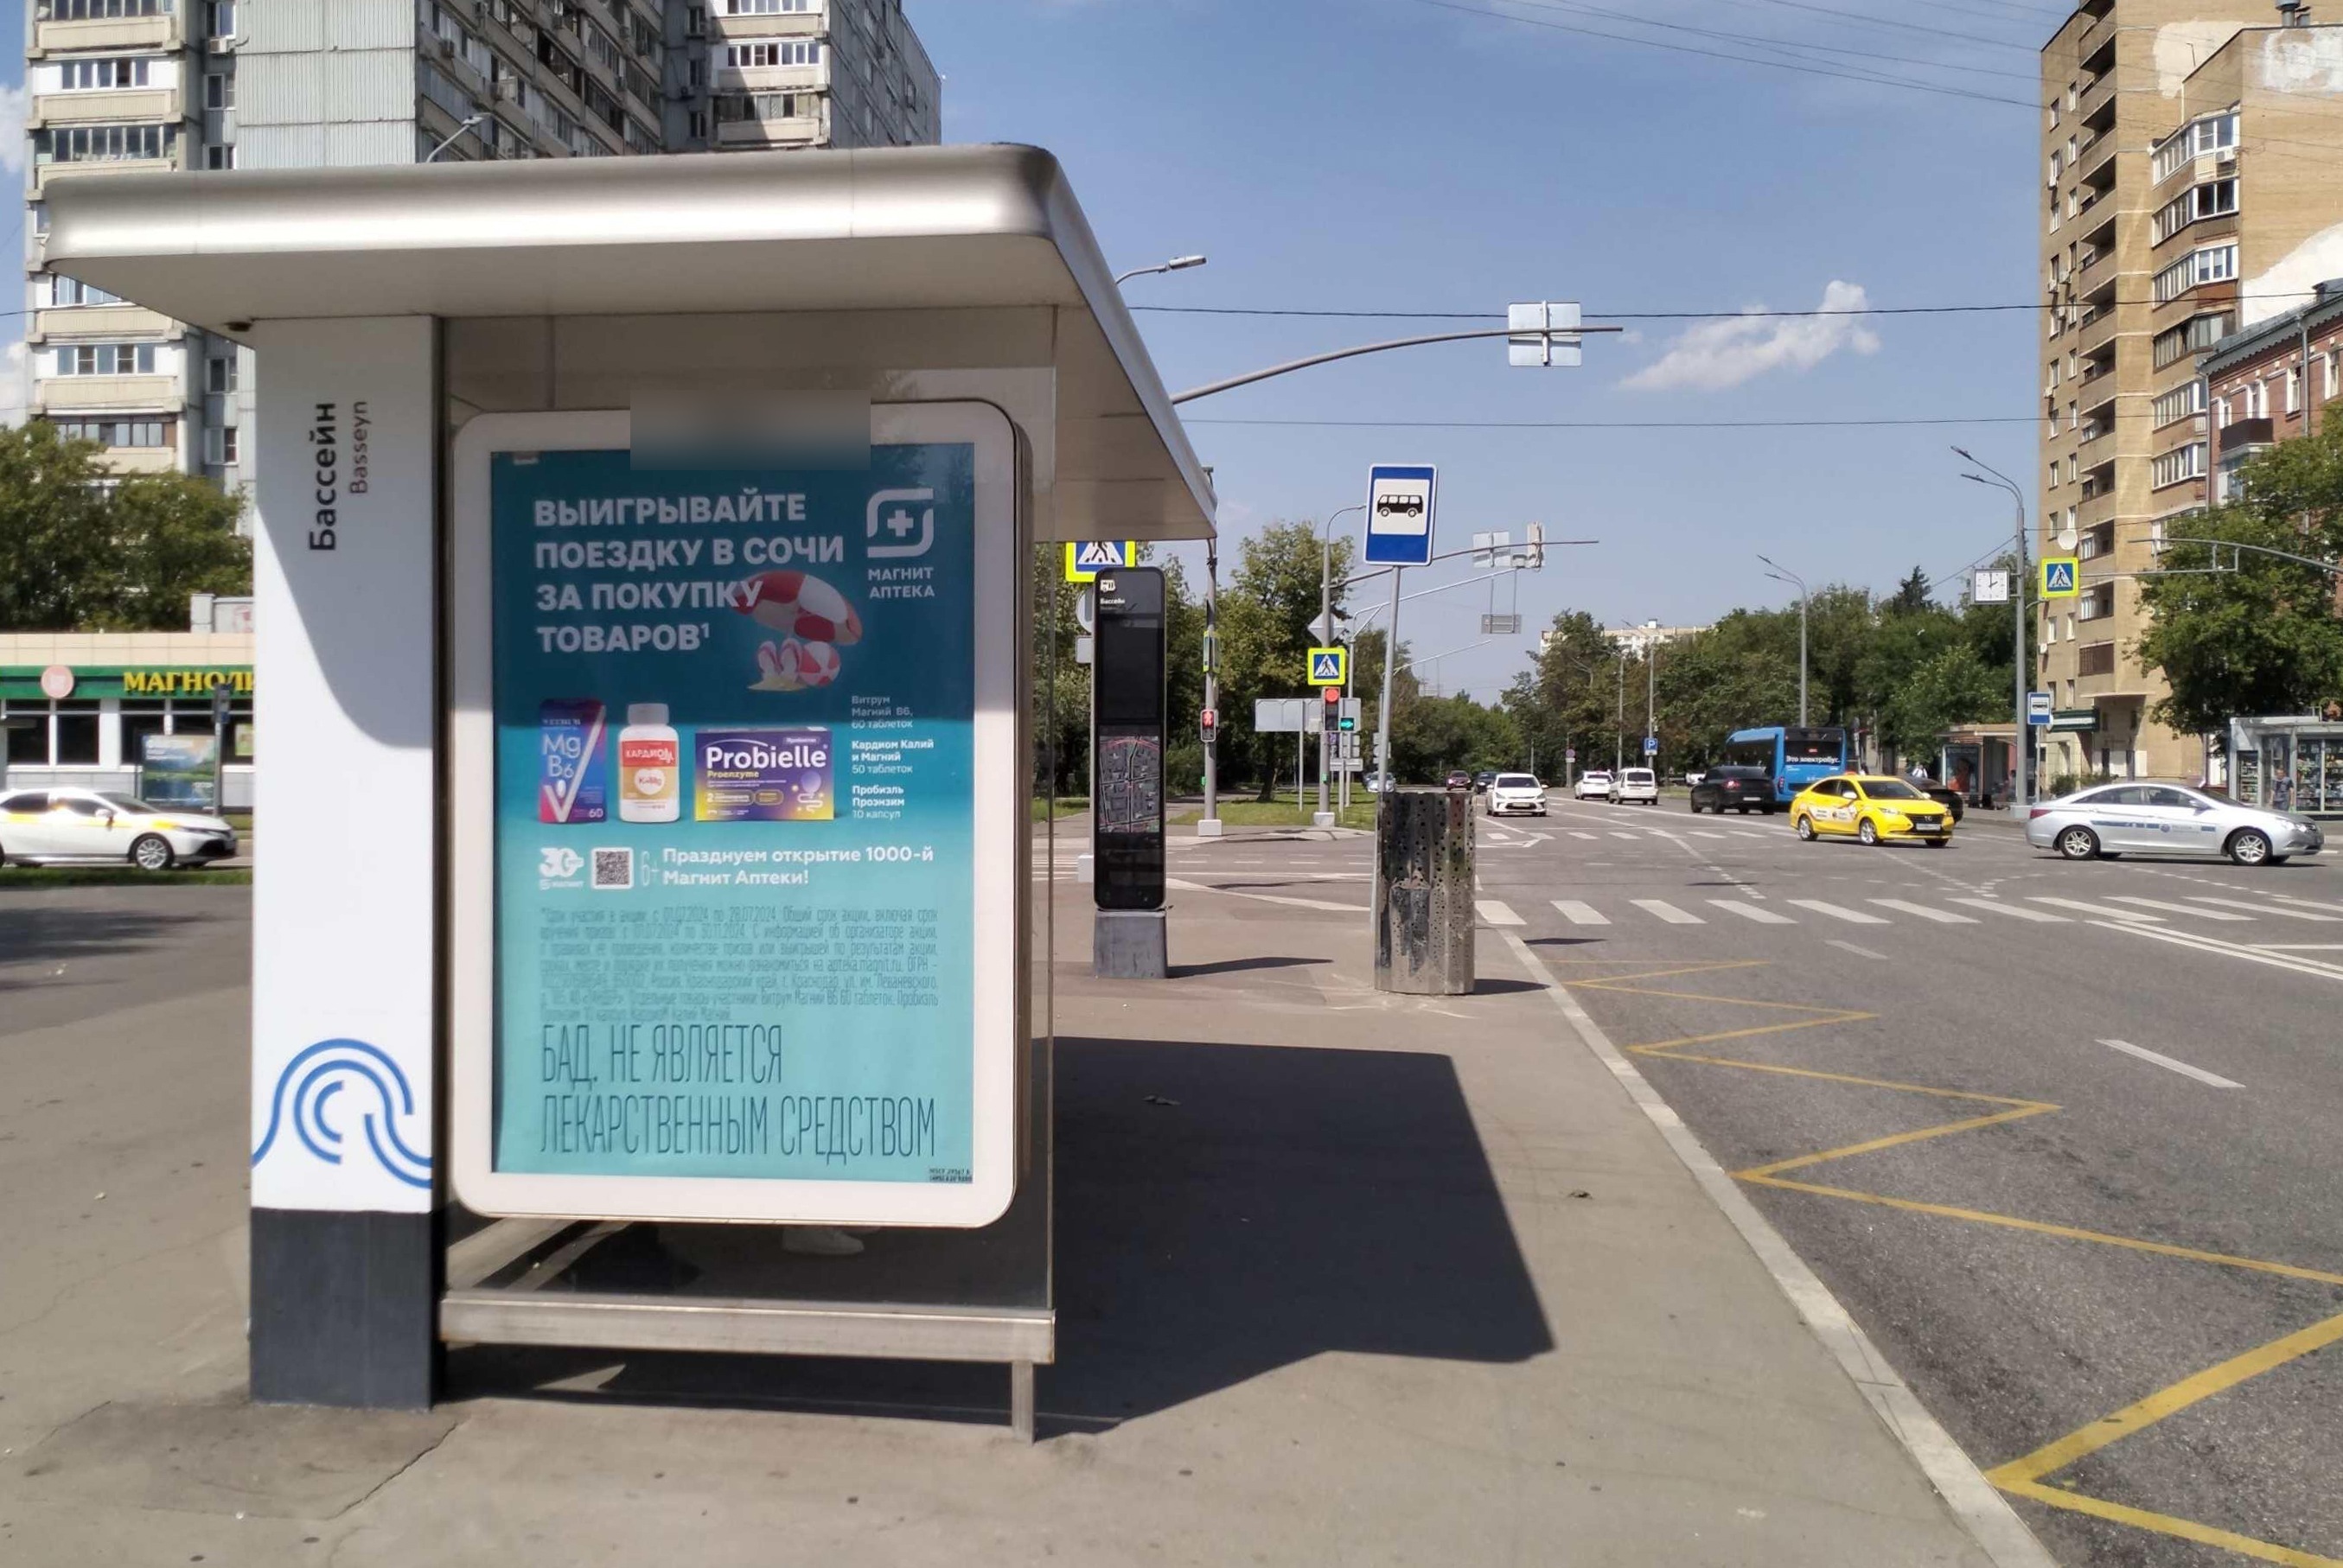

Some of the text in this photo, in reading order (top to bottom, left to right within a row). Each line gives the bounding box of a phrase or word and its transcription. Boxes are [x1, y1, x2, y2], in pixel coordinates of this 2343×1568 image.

[350, 401, 372, 494] Basseyn
[309, 403, 336, 551] Бассейн
[534, 487, 806, 526] ВЫИГРЫВАЙТЕ
[536, 536, 844, 571] ПОЕЗДКУ В СОЧИ
[867, 567, 935, 581] МАГНИТ
[537, 580, 763, 610] ЗА ПОКУПКУ
[869, 583, 935, 599] АПТЕКА
[852, 696, 891, 705] Витрум
[852, 707, 891, 717] Магний
[852, 719, 913, 729] 60 таблеток
[542, 733, 581, 758] Mg
[852, 738, 934, 750] Кардиом Калий
[706, 746, 827, 769] Probielle
[852, 751, 901, 762] и Магний
[707, 770, 760, 780] Proenzyme
[852, 763, 913, 774] 50 таблеток
[589, 808, 603, 818] 60
[853, 810, 901, 820] 10 капсул
[662, 846, 934, 865] Празднуем открытие 1000-й
[662, 870, 809, 885] Магнит Аптеки!
[610, 1024, 642, 1083] НЕ
[652, 1023, 782, 1084] ЯВЛЯЕТСЯ
[541, 1094, 936, 1165] ЛЕКАРСТВЕННЫМ СРЕДСТВОМ
